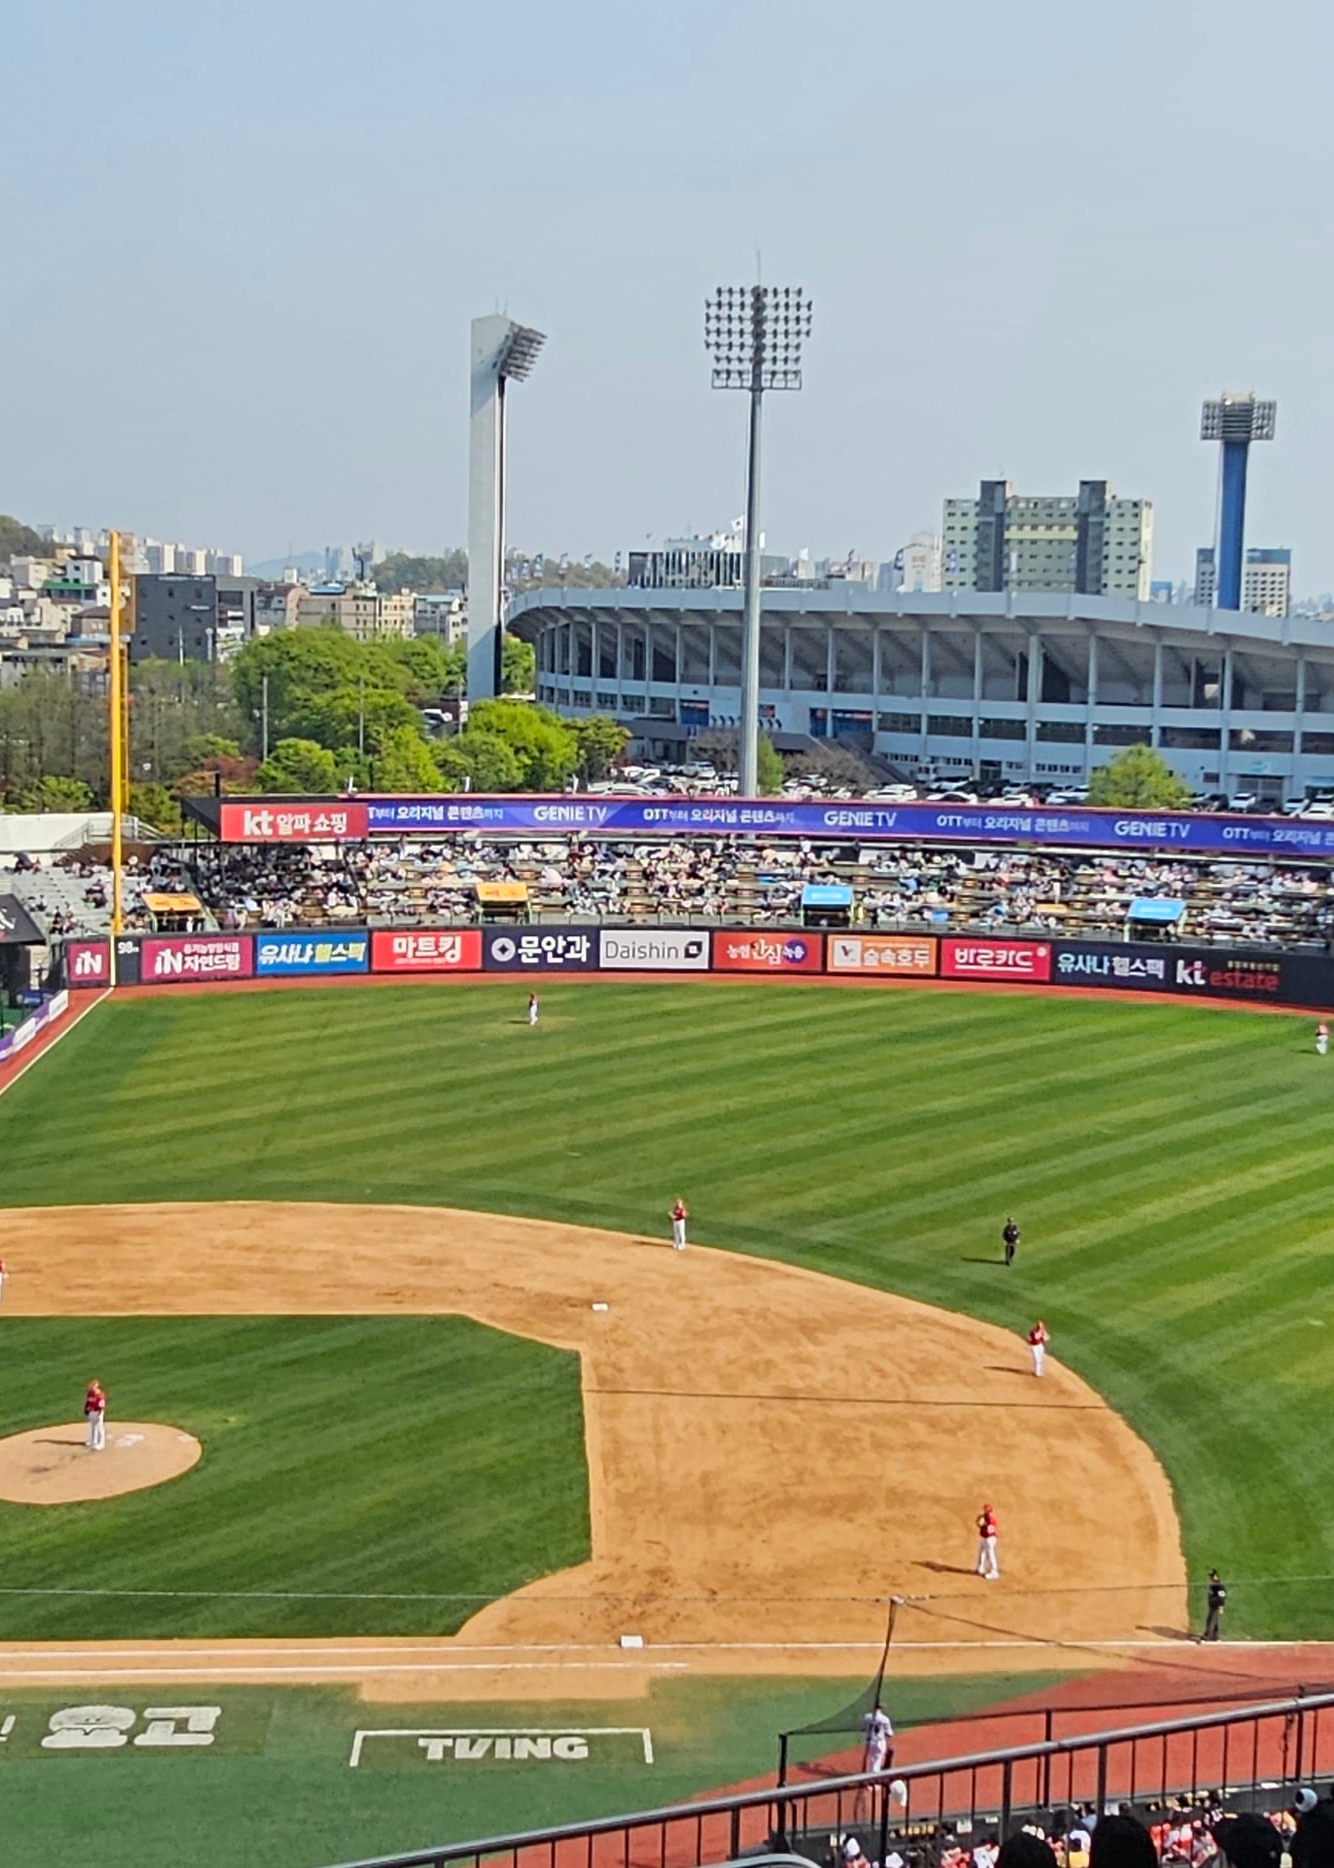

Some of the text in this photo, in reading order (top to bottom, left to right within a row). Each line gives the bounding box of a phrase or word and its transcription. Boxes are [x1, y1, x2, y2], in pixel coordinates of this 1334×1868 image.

[243, 811, 347, 835] kt 알파 쇼핑
[396, 806, 445, 821] 오리지널
[533, 807, 607, 821] GENIE TV
[690, 809, 737, 823] 오리지널
[823, 811, 897, 827] GENIE TV
[983, 815, 1031, 832] 오리지널
[1114, 820, 1191, 838] GENIE TV
[1272, 830, 1321, 845] 오리지널
[258, 943, 314, 965] 유사나
[393, 935, 462, 964] 마트킹
[517, 935, 591, 964] 문안과
[605, 939, 680, 961] Daishin
[184, 953, 240, 972] 자연드림
[1057, 952, 1109, 975] 유사나
[1175, 959, 1207, 986] kt
[1209, 968, 1281, 991] estate
[417, 1735, 589, 1761] TVING
